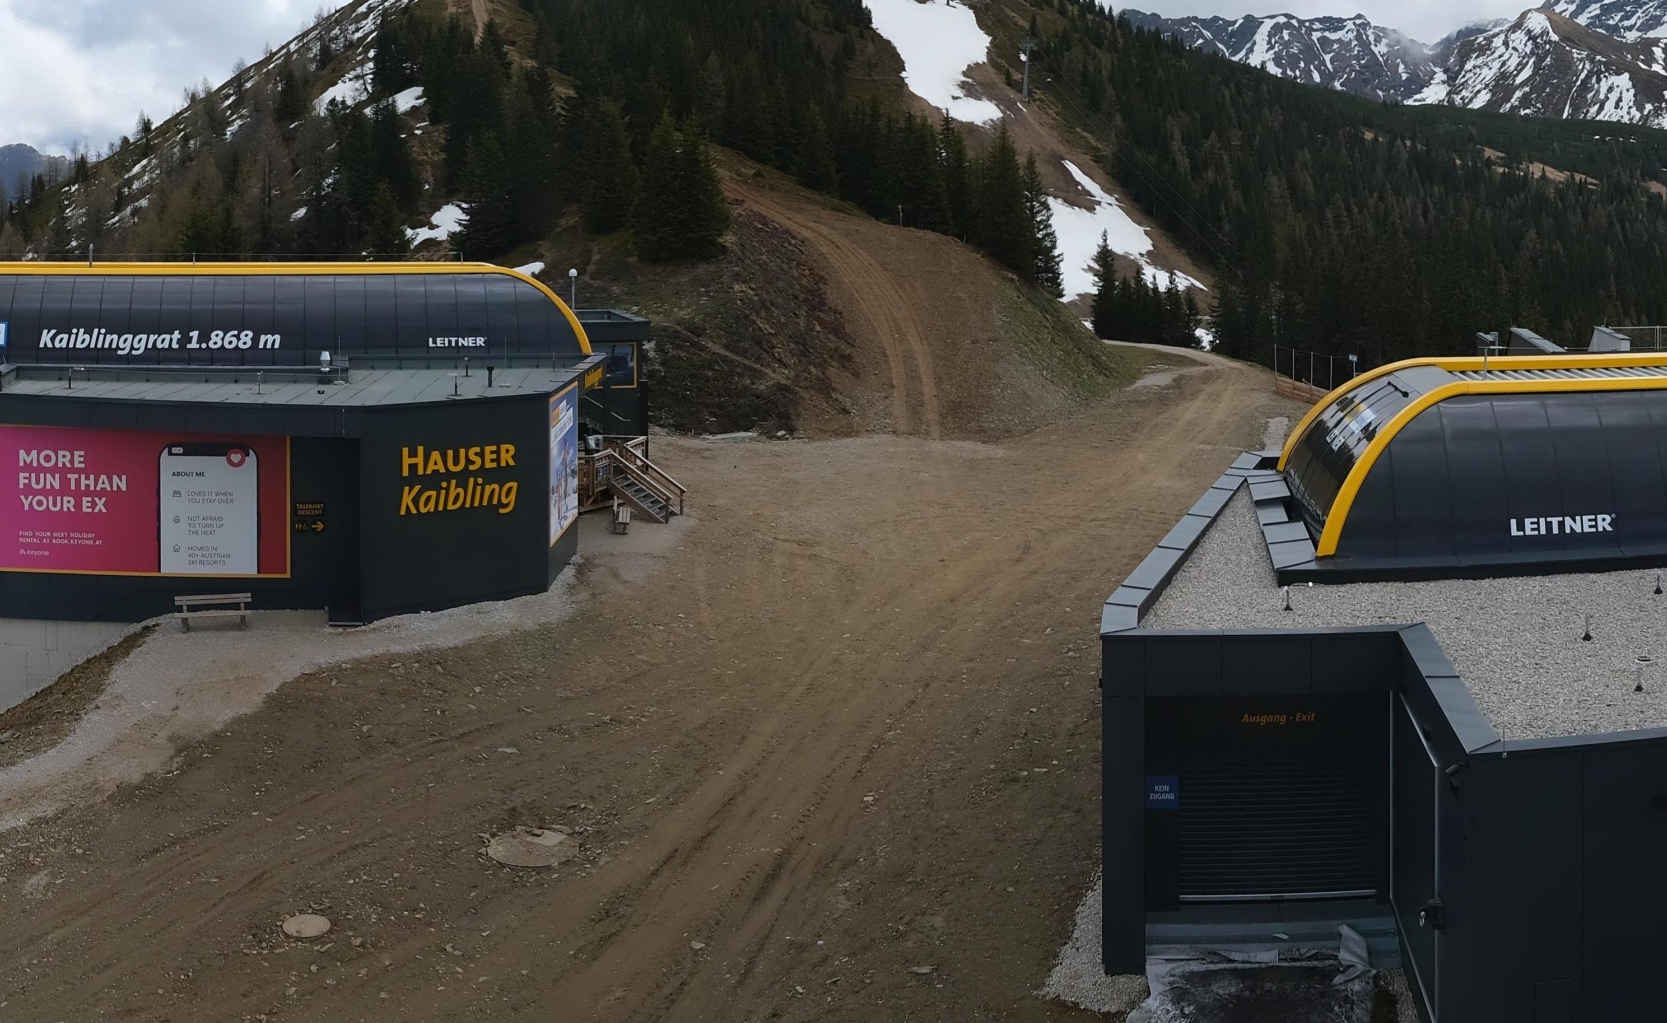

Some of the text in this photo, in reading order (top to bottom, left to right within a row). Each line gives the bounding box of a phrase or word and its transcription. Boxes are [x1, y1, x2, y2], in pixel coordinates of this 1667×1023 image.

[38, 328, 281, 355] Kaiblinggrat 1.868 m
[428, 337, 487, 347] LEITNER
[18, 449, 85, 468] MORE
[401, 443, 516, 477] HAUSER
[19, 472, 127, 491] FUN THAN
[20, 495, 107, 513] YOUR EX
[400, 477, 518, 516] Kaibling
[1510, 514, 1614, 536] LEITNER
[1241, 713, 1287, 725] Ausgang
[1295, 711, 1316, 722] Exit
